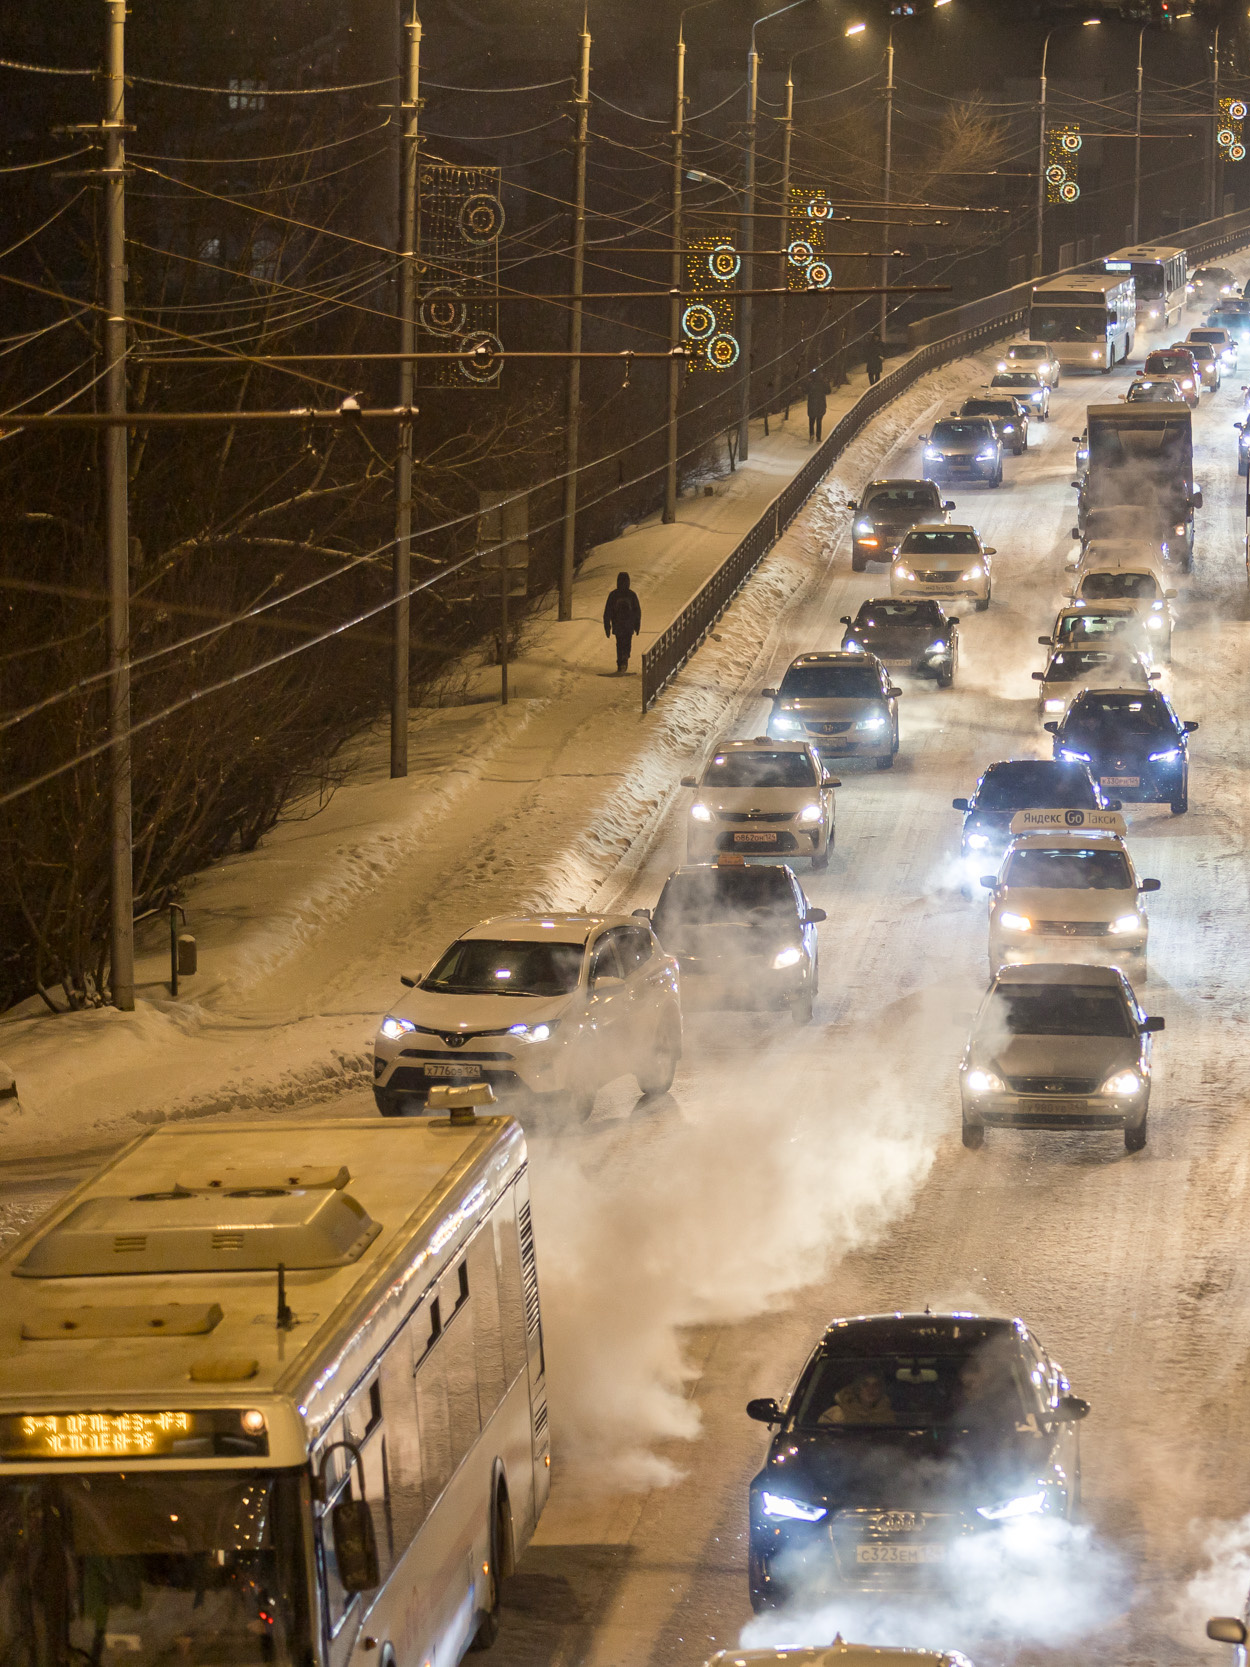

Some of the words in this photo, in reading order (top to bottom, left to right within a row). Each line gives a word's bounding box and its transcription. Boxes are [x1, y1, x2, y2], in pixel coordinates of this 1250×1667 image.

[1023, 812, 1061, 824] Яндекс
[1067, 811, 1082, 824] Go
[1087, 812, 1116, 824] Такси
